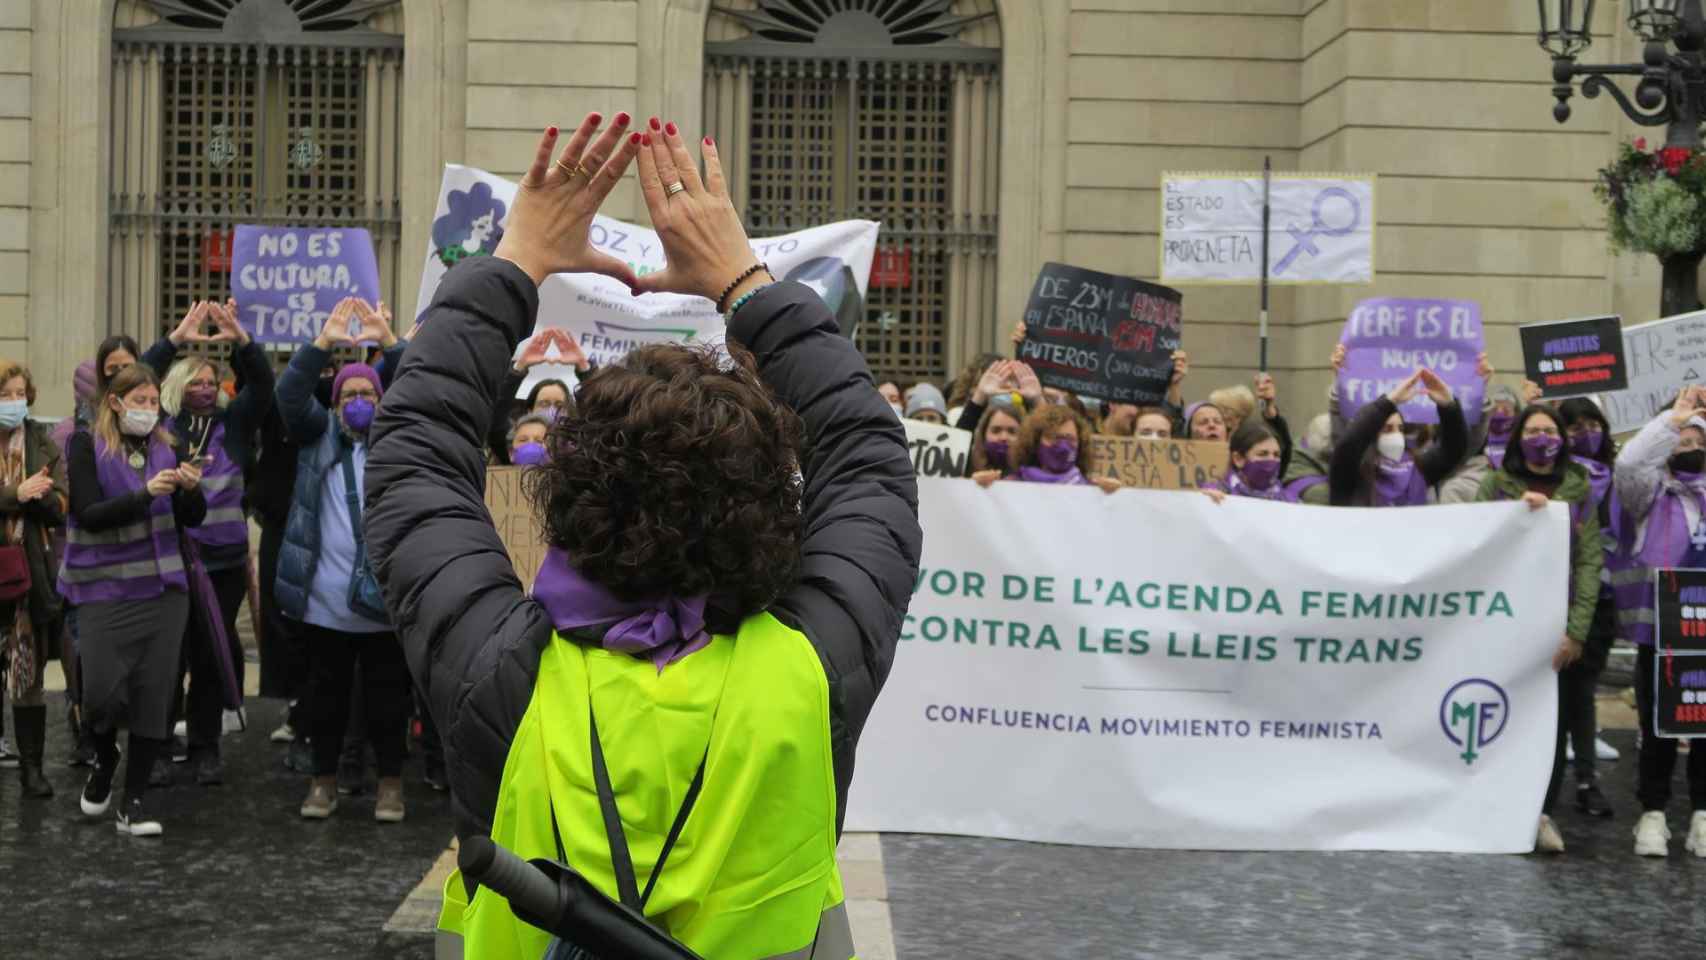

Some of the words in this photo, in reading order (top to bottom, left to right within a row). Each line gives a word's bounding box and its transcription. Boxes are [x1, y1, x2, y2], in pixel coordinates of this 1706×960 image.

[1167, 195, 1224, 211] ESTADO
[1167, 215, 1184, 229] ES
[258, 232, 298, 257] NO
[307, 232, 343, 257] ES
[590, 224, 629, 253] OZ
[638, 241, 651, 257] Y
[240, 262, 359, 293] CULTURA,
[1039, 276, 1070, 300] DE
[1070, 282, 1113, 310] 23M
[287, 291, 317, 313] ES
[247, 303, 330, 337] TORT
[1450, 306, 1478, 339] EL
[1022, 340, 1099, 372] PUTEROS
[1382, 349, 1457, 371] NUEVO
[909, 432, 965, 478] TÓN
[1091, 440, 1196, 465] ESTAMOS
[1002, 574, 1055, 603] DE
[1300, 590, 1514, 619] FEMINISTA
[1079, 626, 1150, 656] LES
[1168, 631, 1278, 662] LLEIS
[1294, 637, 1423, 663] TRANS
[925, 704, 1091, 734] CONFLUENCIA
[1101, 717, 1250, 738] MOVIMIENTO
[1260, 720, 1383, 740] FEMINISTA
